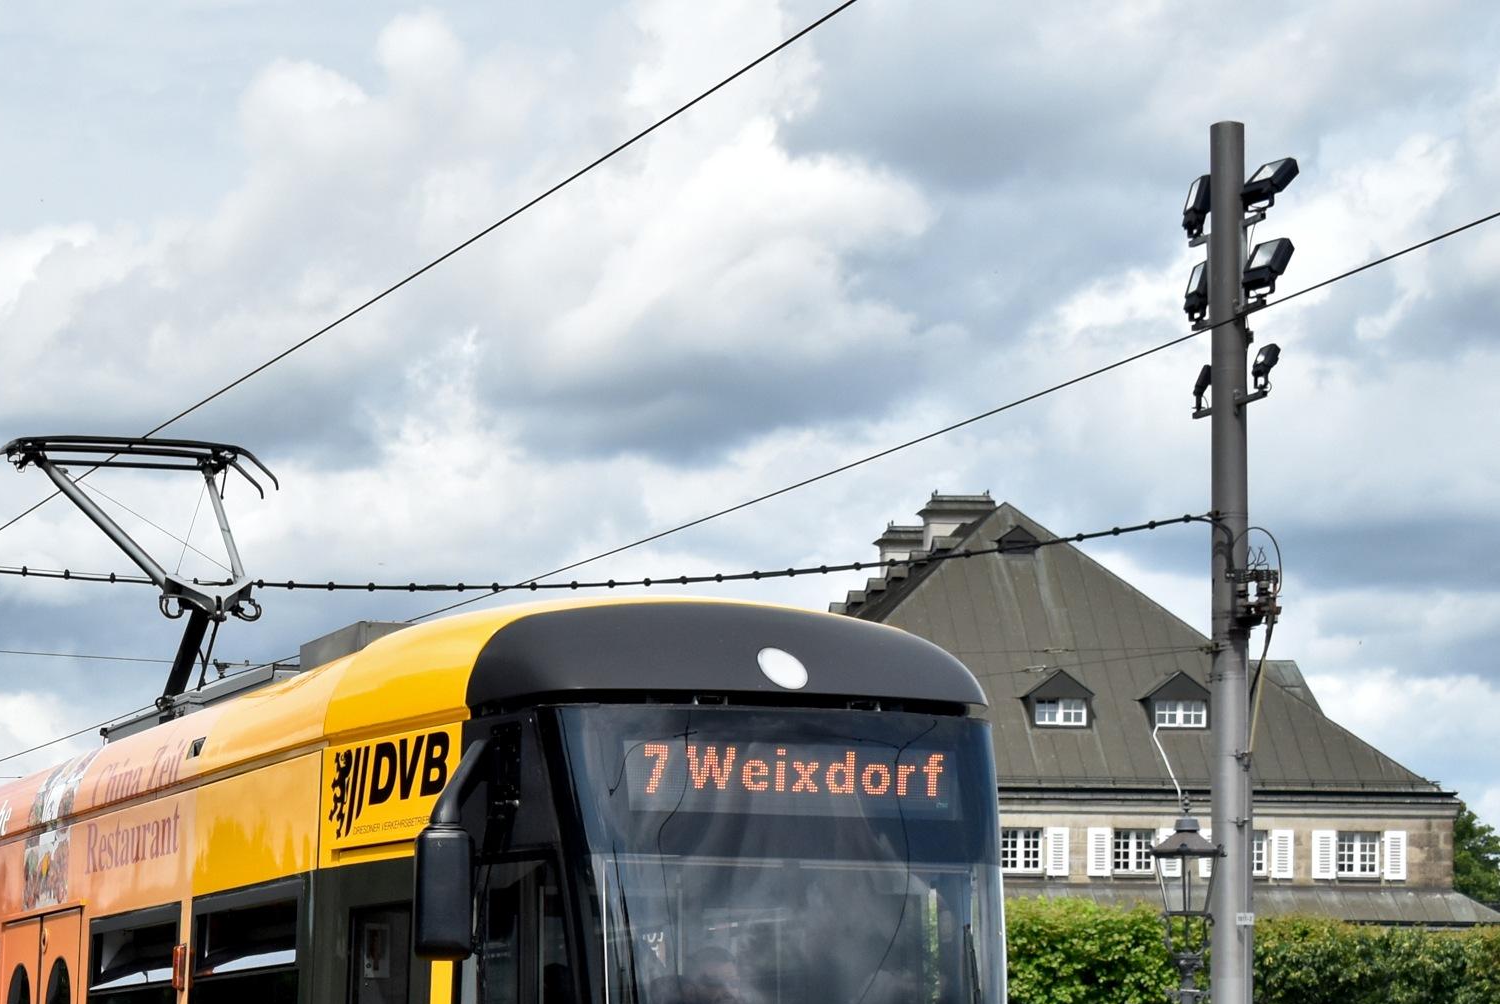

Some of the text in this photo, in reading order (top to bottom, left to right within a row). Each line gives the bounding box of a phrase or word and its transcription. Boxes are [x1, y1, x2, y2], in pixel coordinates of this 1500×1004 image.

[91, 738, 188, 807] China Zeit
[368, 731, 450, 806] DVB
[644, 744, 944, 797] 7 Weixdorf
[85, 802, 180, 876] Restaurant
